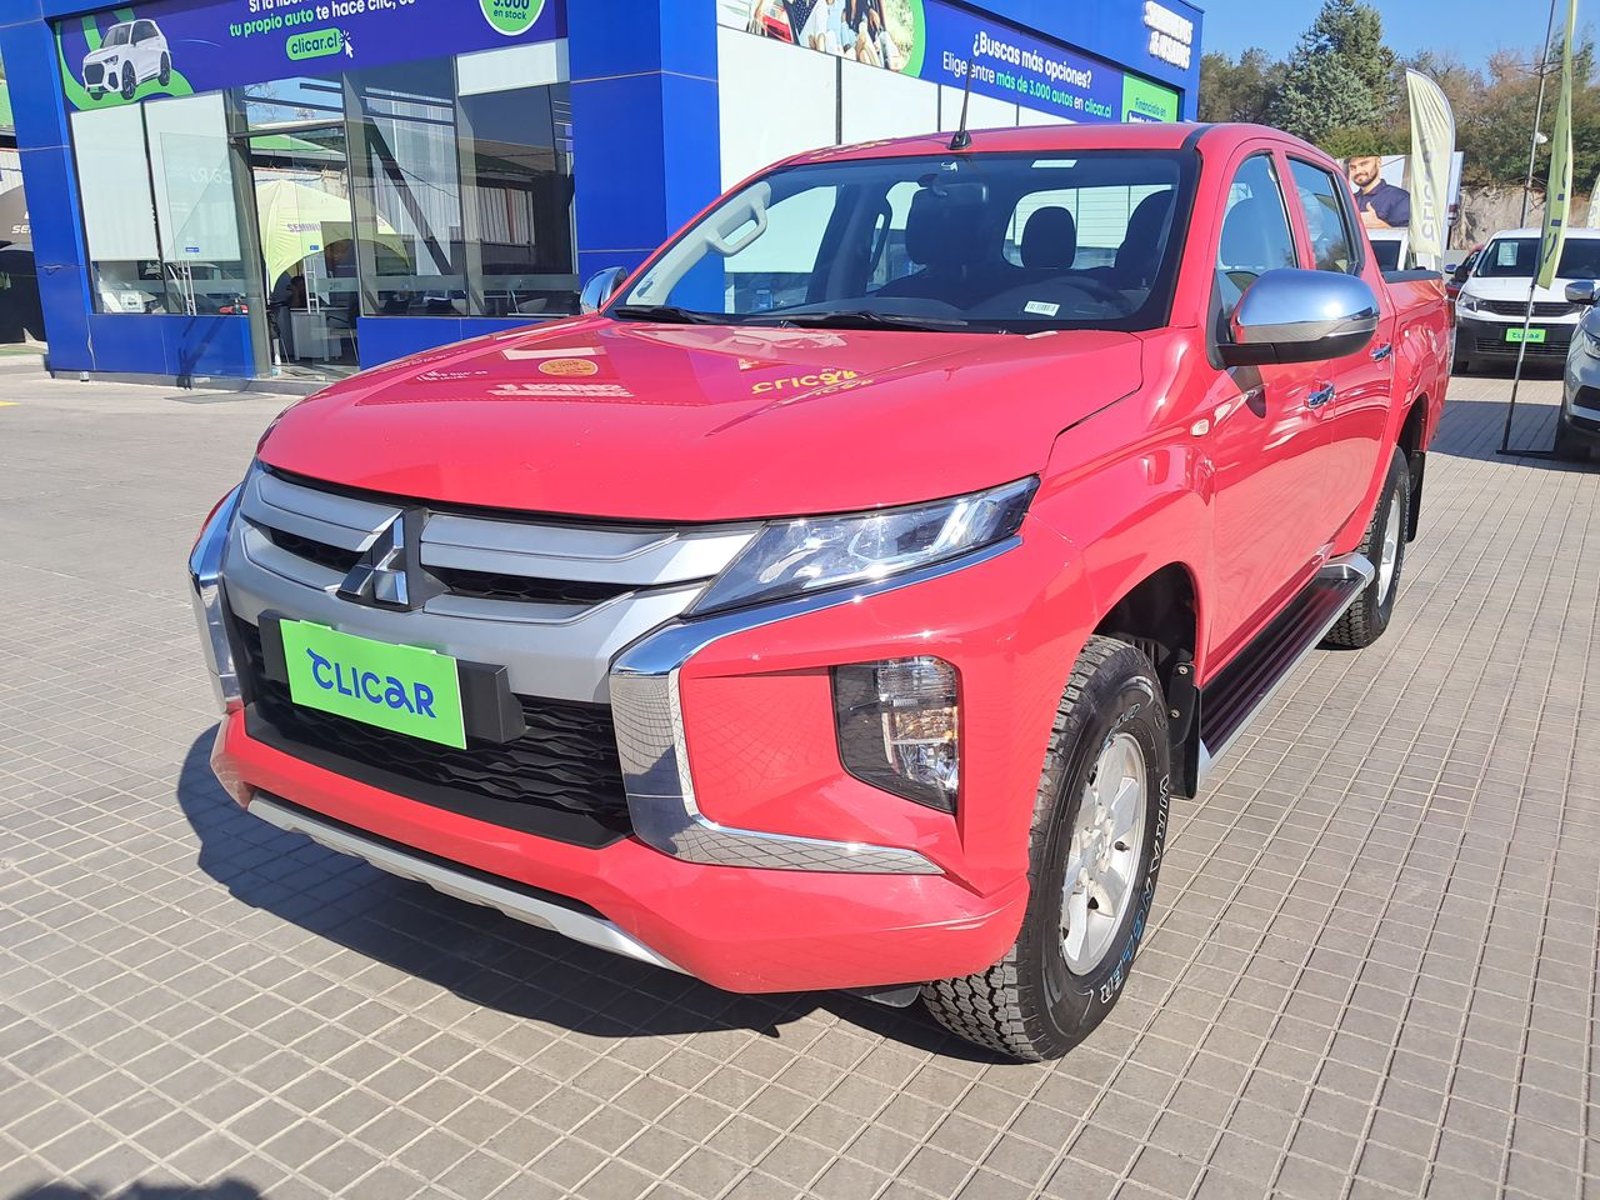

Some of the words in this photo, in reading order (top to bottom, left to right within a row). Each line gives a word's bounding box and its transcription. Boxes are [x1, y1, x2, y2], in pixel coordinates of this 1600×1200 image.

[229, 23, 242, 37] tu
[244, 13, 283, 38] propio
[284, 9, 314, 26] auto
[315, 5, 330, 20] te
[331, 0, 365, 18] hace
[493, 9, 504, 17] en
[504, 10, 527, 20] stock
[291, 32, 338, 55] clicar.cl
[973, 31, 1020, 66] ¿Buscas
[1021, 49, 1043, 74] más
[1045, 59, 1092, 90] opciones?
[943, 50, 967, 78] Elige
[970, 63, 995, 84] entre
[996, 69, 1016, 90] más
[1017, 75, 1028, 94] de
[1029, 79, 1050, 101] 3.000
[1051, 89, 1073, 108] autos
[1074, 97, 1084, 111] en
[1084, 98, 1112, 119] clicar.cl
